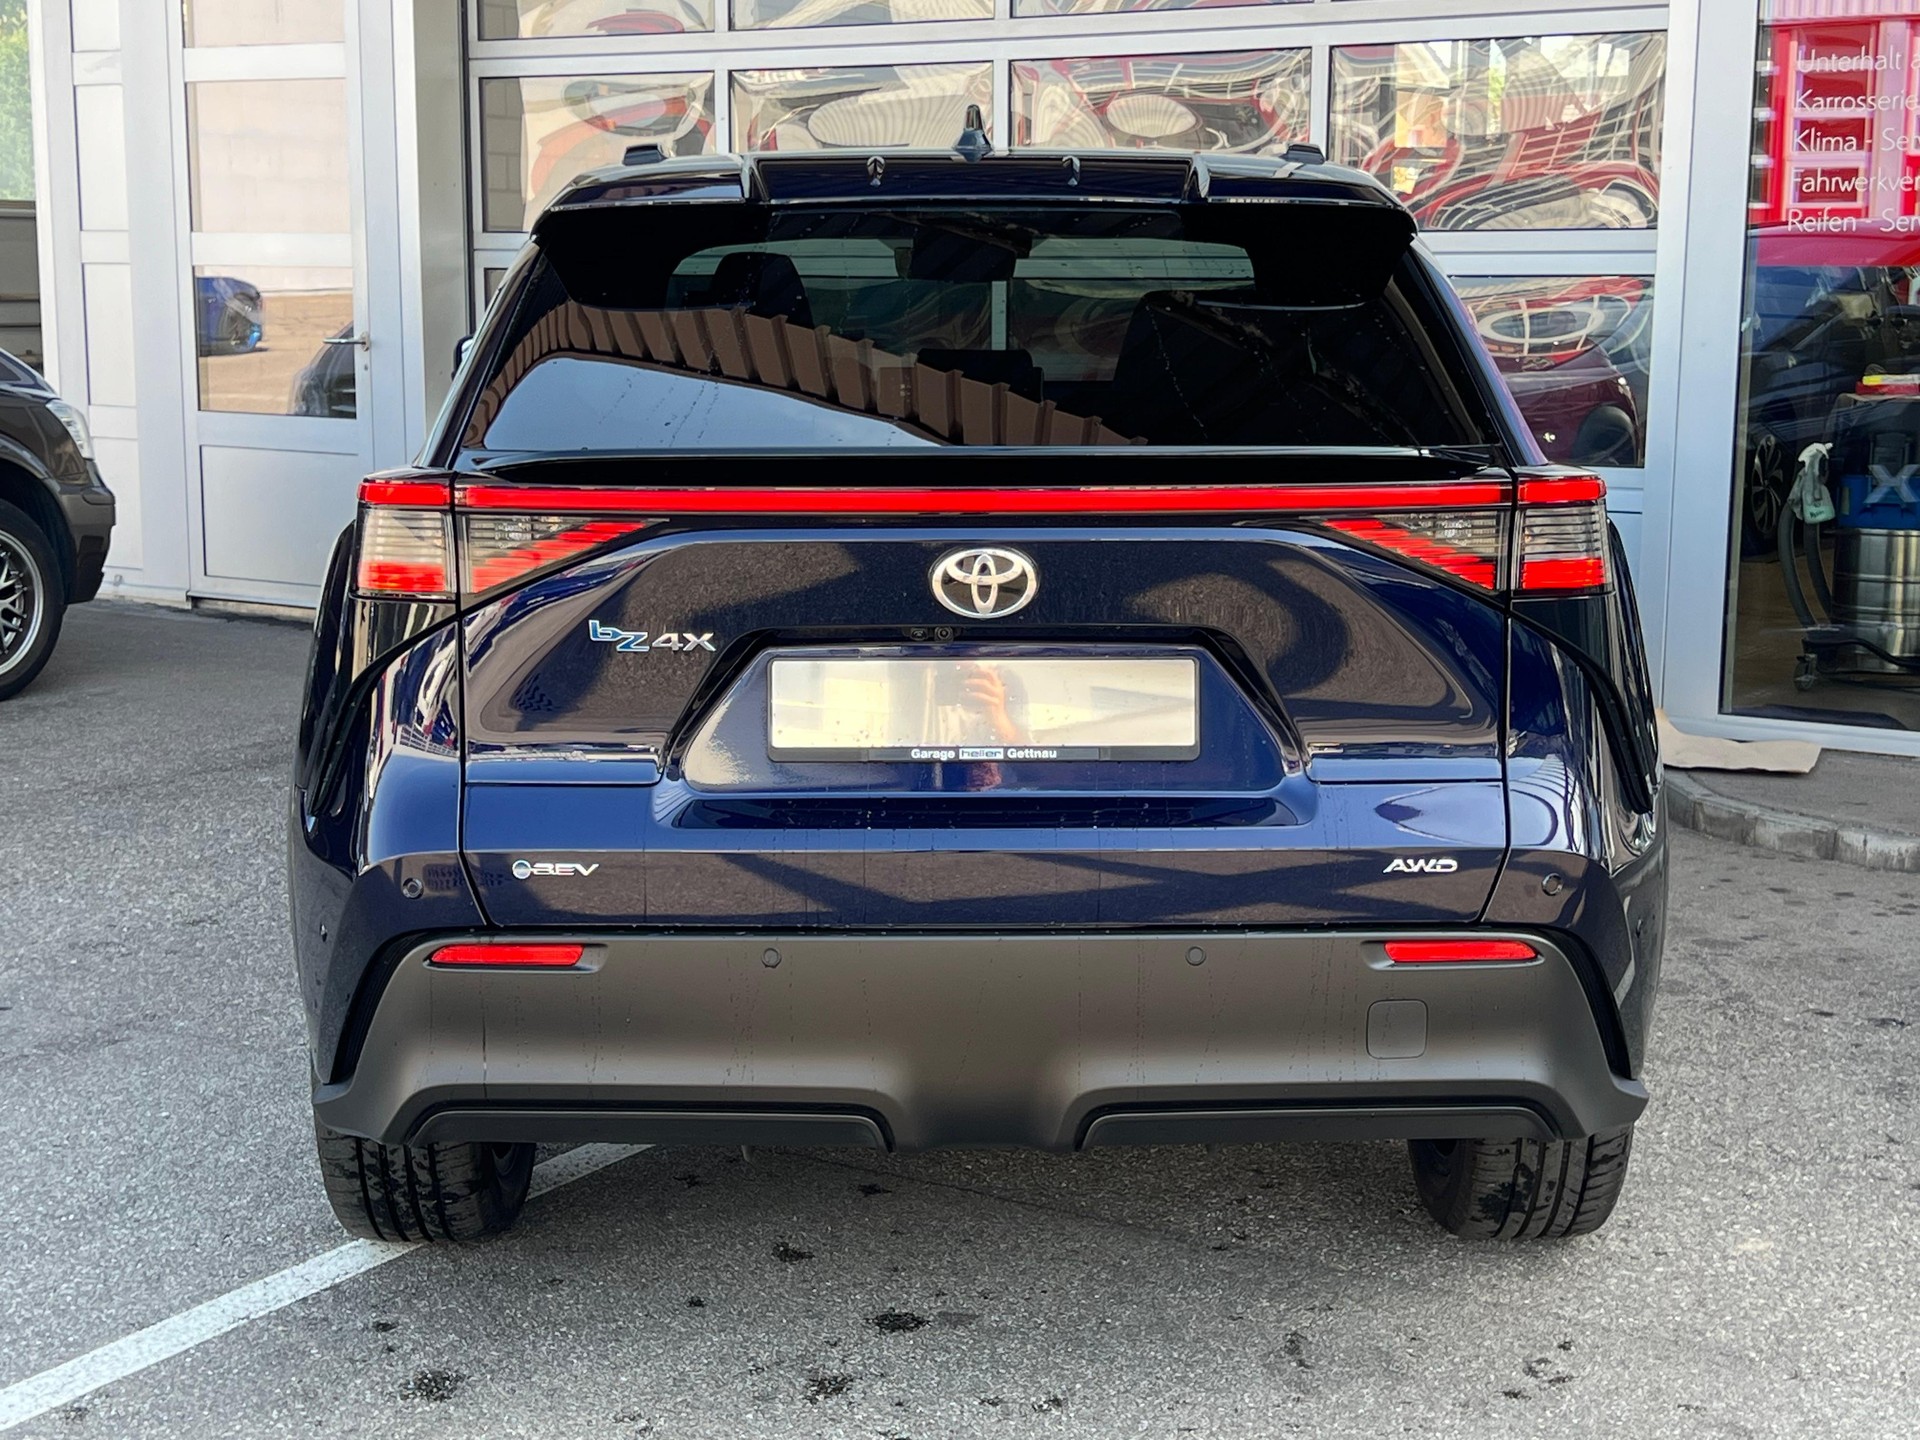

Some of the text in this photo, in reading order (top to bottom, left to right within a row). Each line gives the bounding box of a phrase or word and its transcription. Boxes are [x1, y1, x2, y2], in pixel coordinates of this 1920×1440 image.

[1797, 44, 1901, 73] Unterhalt
[1796, 89, 1918, 112] Karrosserie
[1793, 127, 1857, 153] Klima
[1881, 127, 1920, 151] Ser
[1787, 207, 1857, 233] Reifen
[1880, 207, 1920, 233] Ser
[910, 748, 955, 760] Garage
[1382, 859, 1458, 873] AWD
